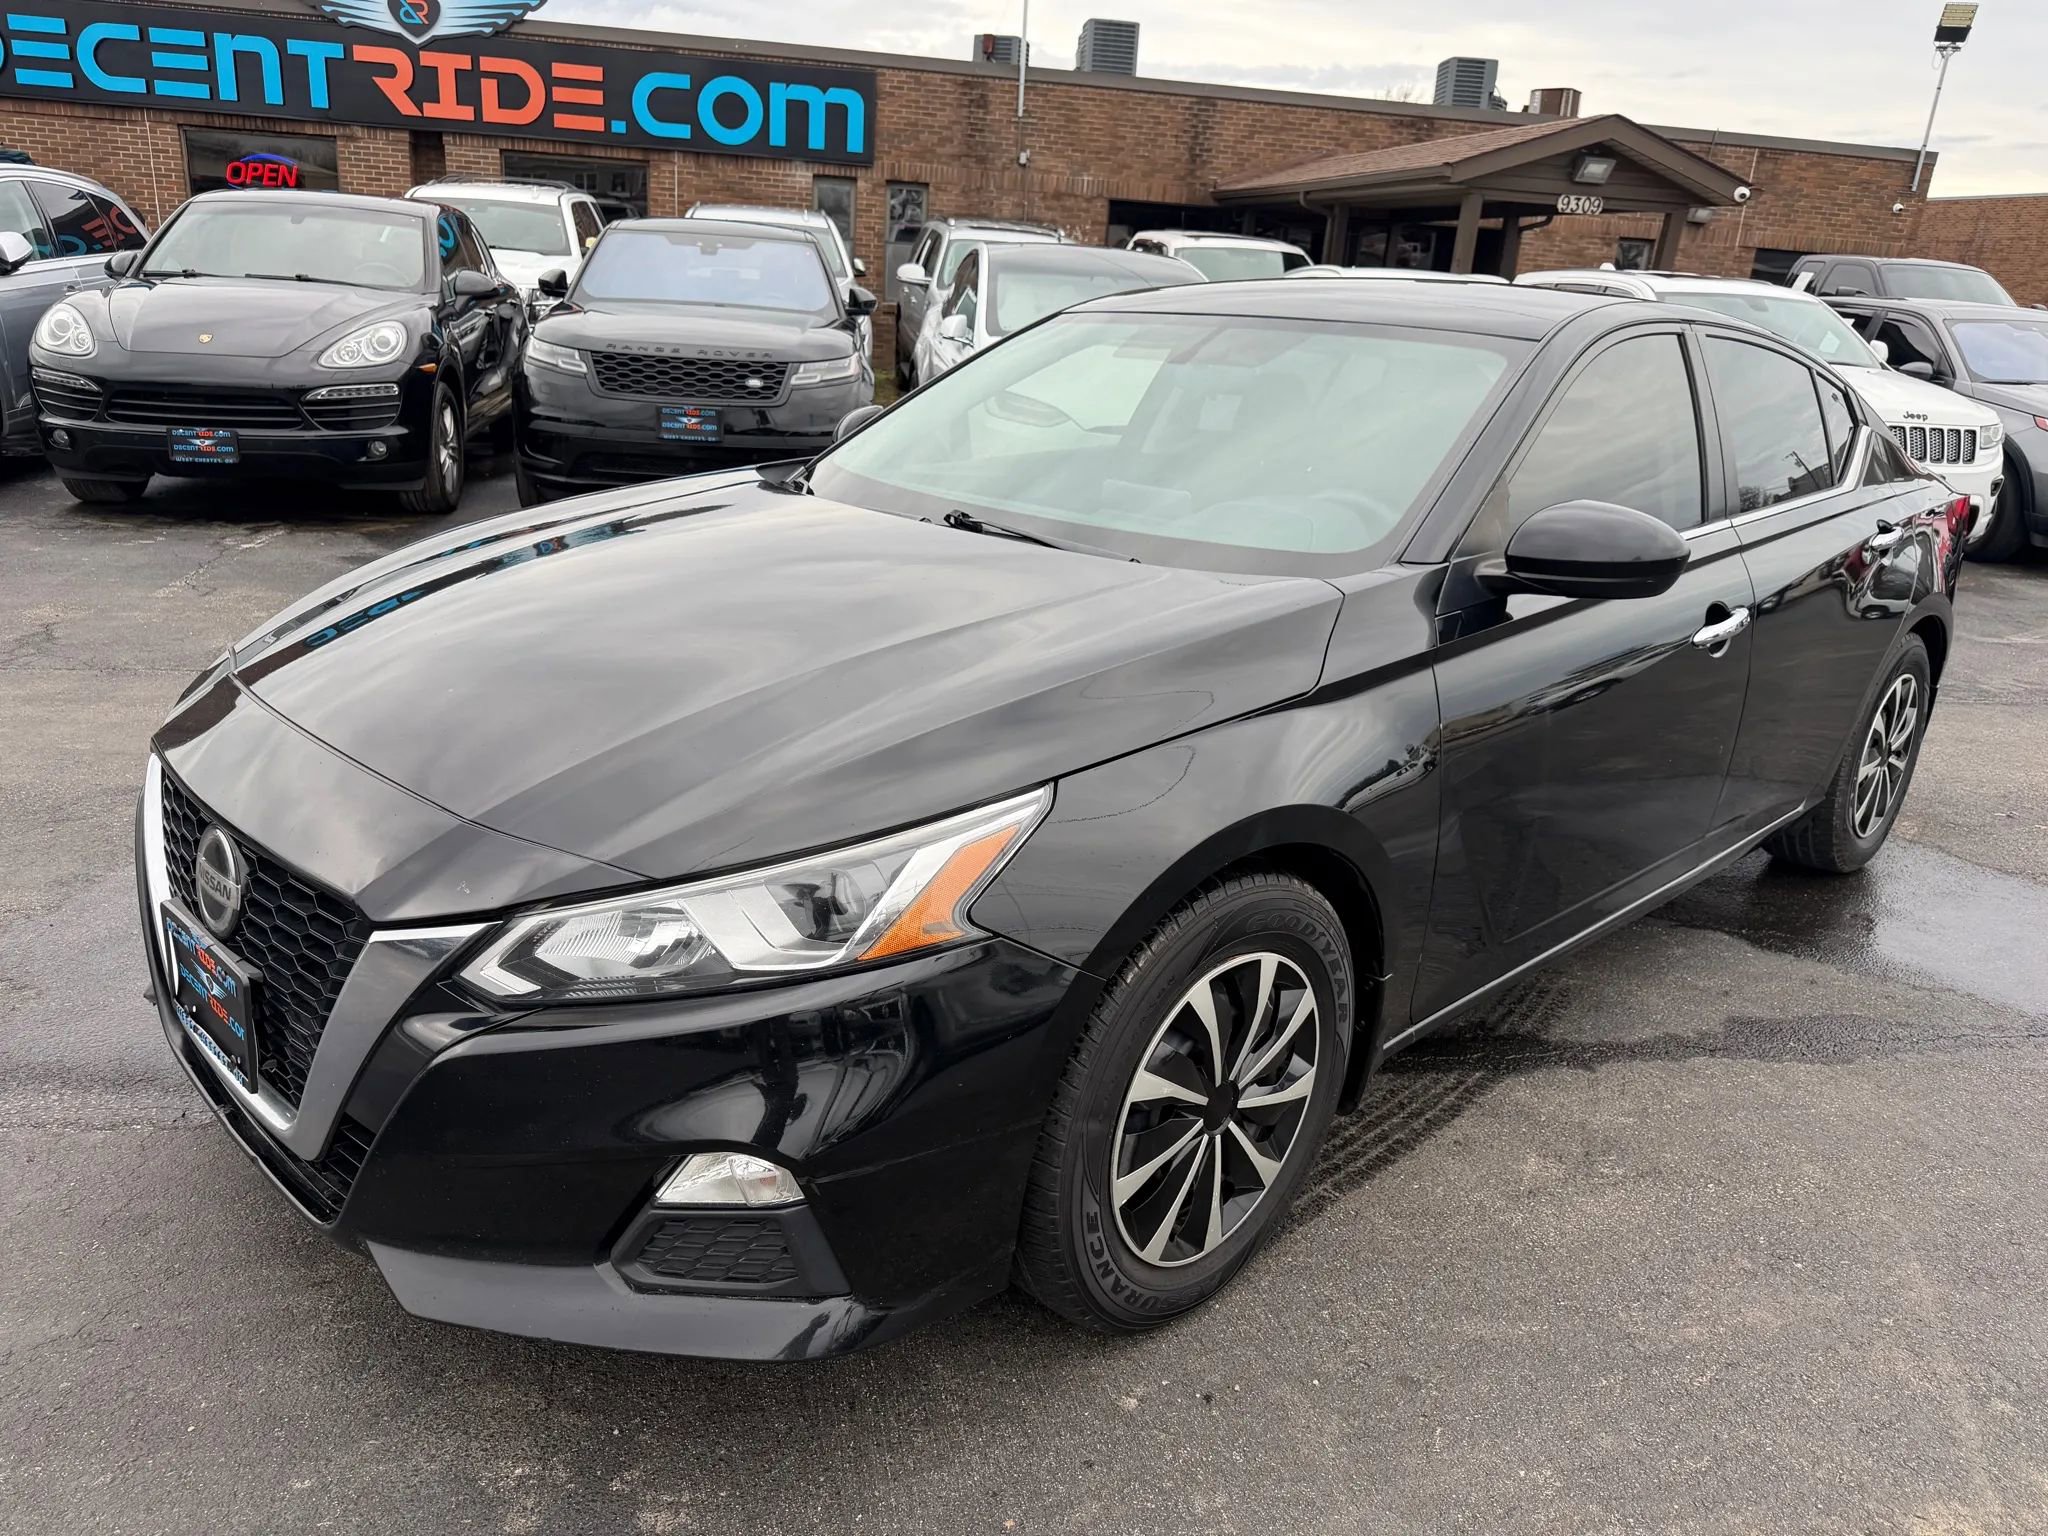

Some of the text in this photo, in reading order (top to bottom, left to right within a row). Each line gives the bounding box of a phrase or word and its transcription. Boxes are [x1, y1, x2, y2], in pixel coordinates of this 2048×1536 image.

[226, 161, 298, 188] OPEN
[1560, 195, 1602, 214] 9309
[606, 343, 773, 359] RANGE ROVER
[1902, 410, 1929, 423] Jeep
[201, 862, 232, 902] NISSAN
[1246, 912, 1349, 1024] GOODYEAR
